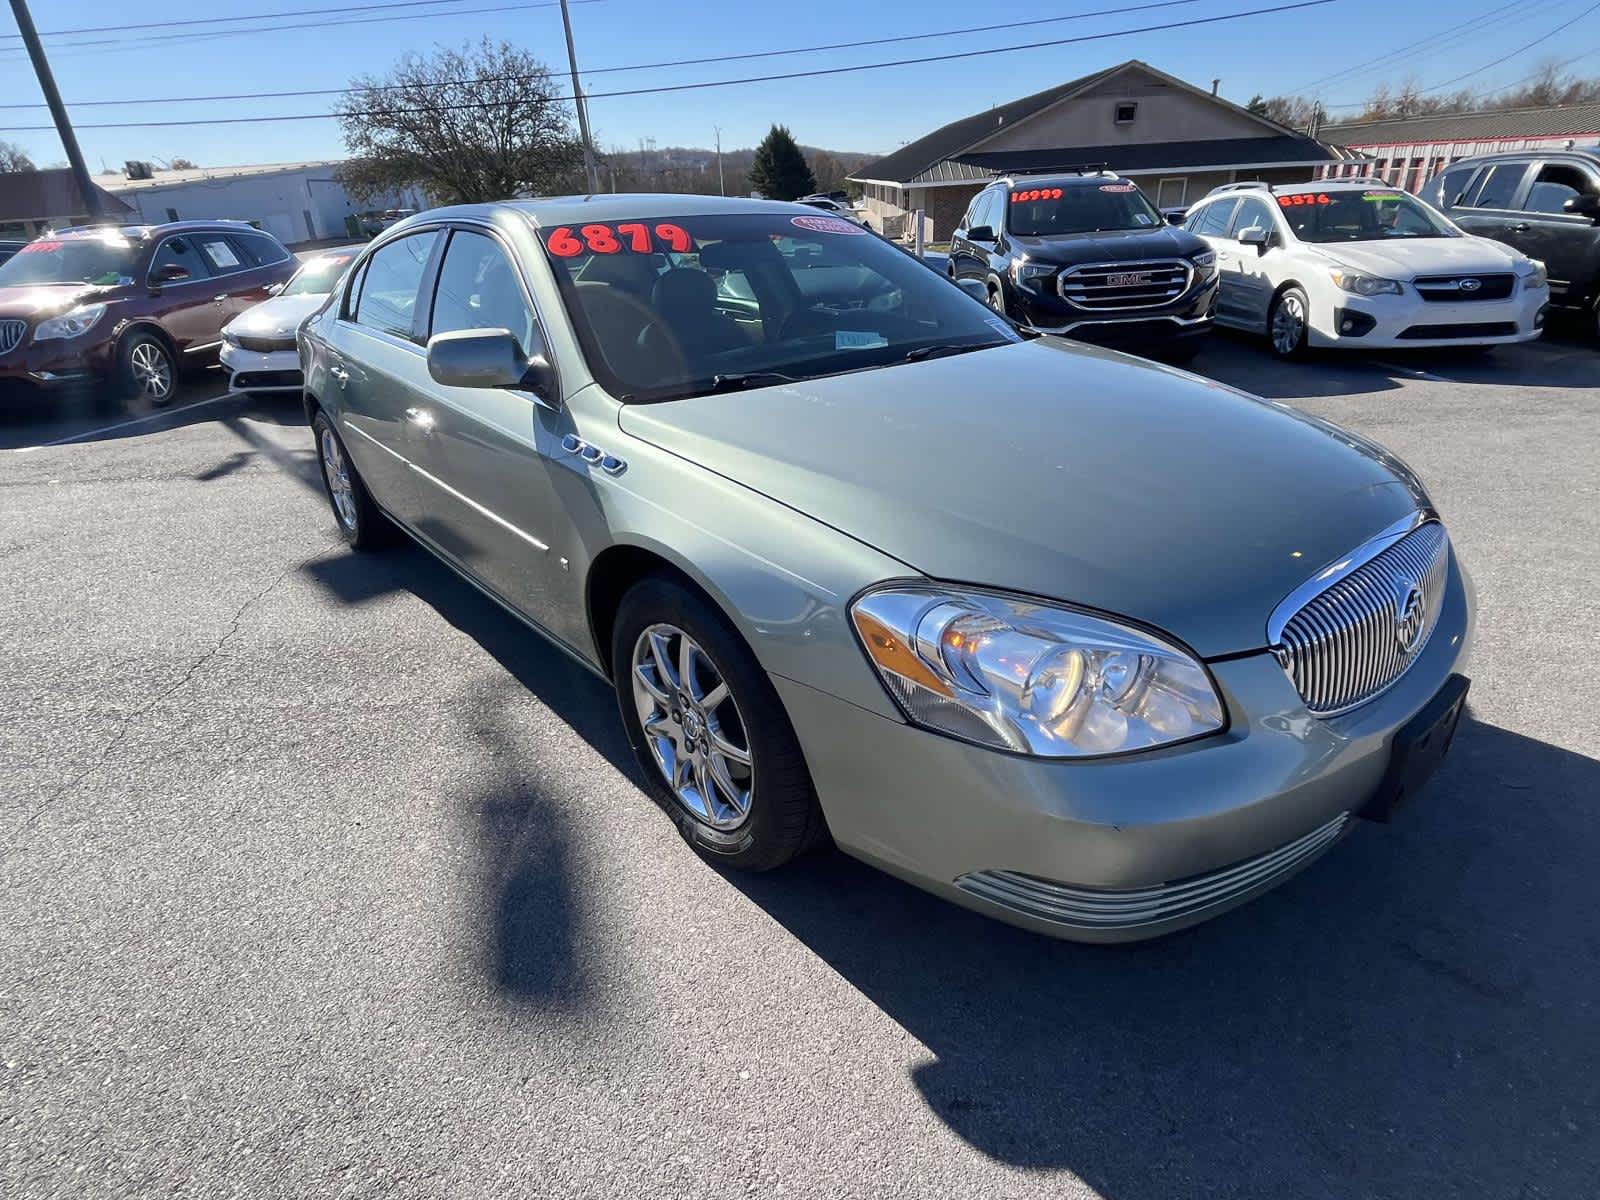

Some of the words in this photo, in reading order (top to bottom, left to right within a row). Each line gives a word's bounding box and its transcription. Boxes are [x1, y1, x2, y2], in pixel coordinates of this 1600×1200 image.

[1011, 187, 1063, 203] 16999
[547, 223, 691, 257] 6879
[1106, 272, 1152, 286] GMC
